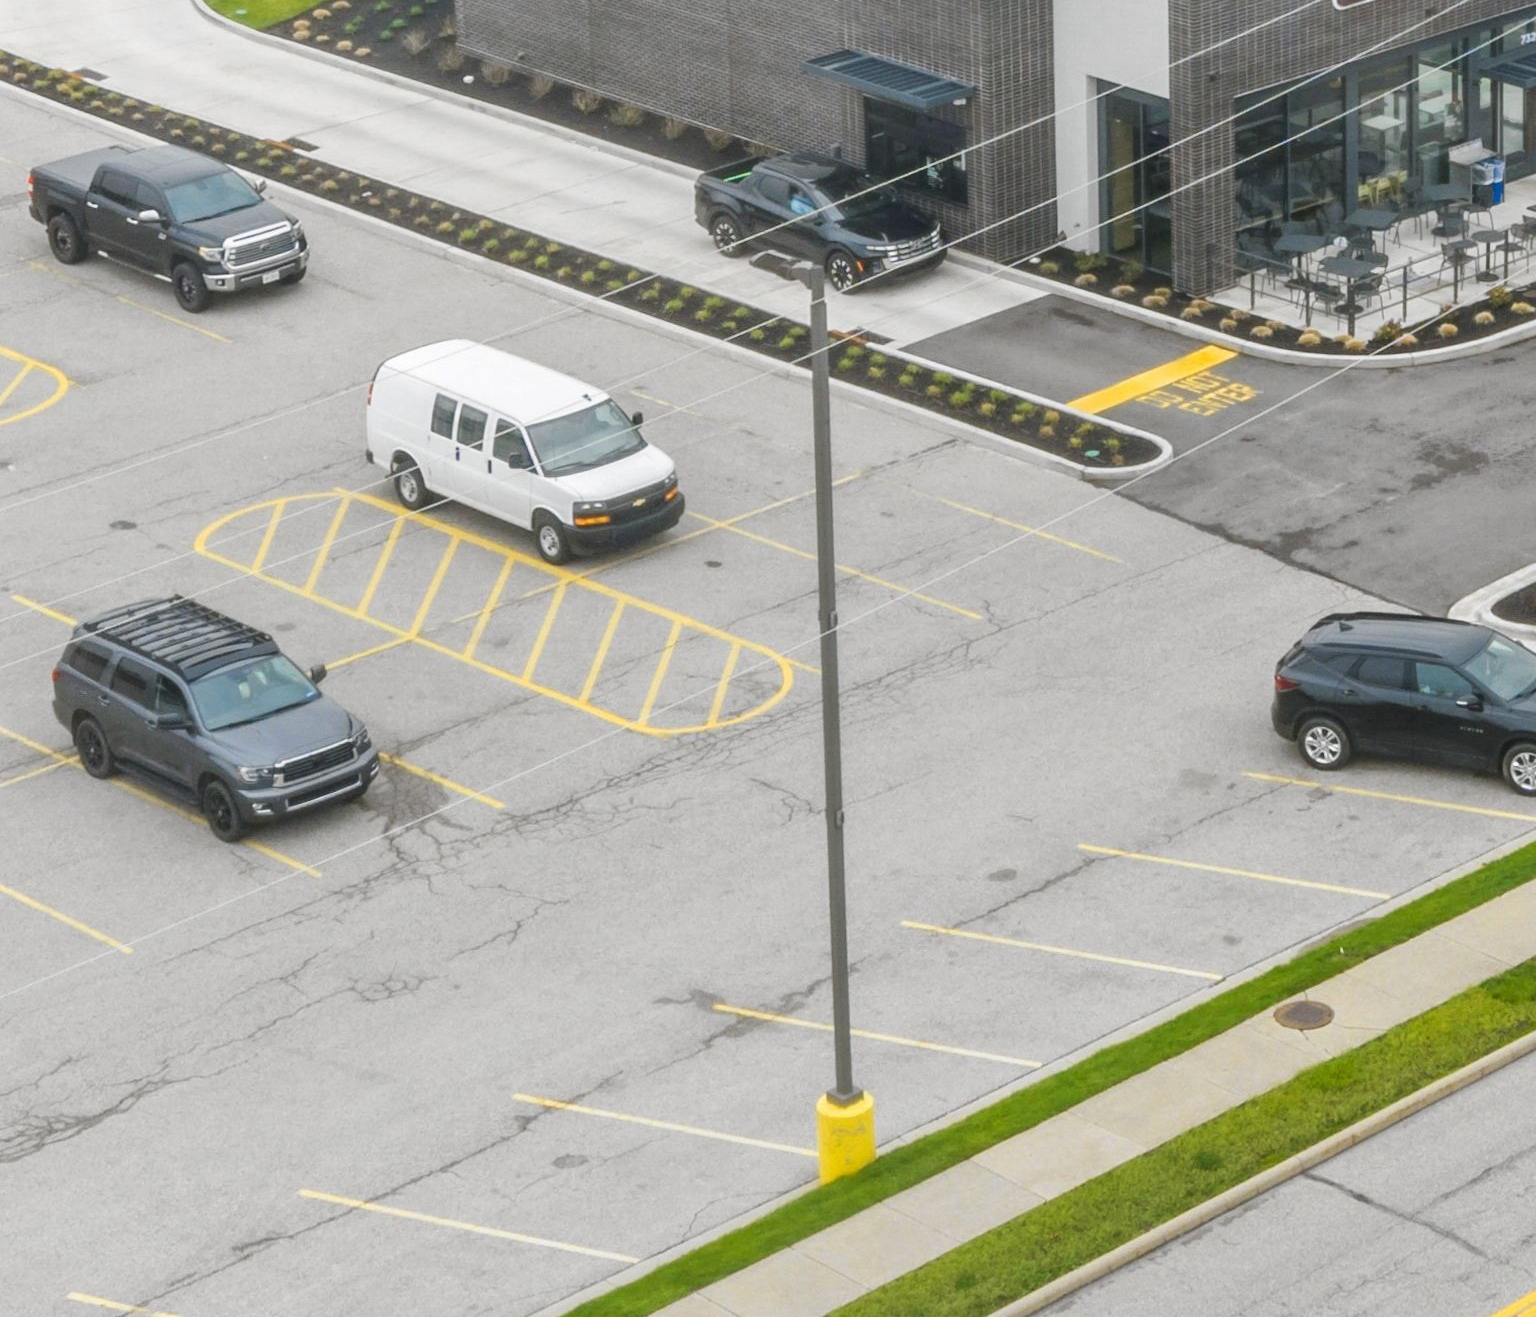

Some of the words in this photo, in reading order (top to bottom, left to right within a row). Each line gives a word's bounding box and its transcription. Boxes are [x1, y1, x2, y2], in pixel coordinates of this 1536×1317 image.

[1135, 390, 1184, 409] DO
[1172, 371, 1230, 394] NOT
[1178, 383, 1259, 416] ENTER
